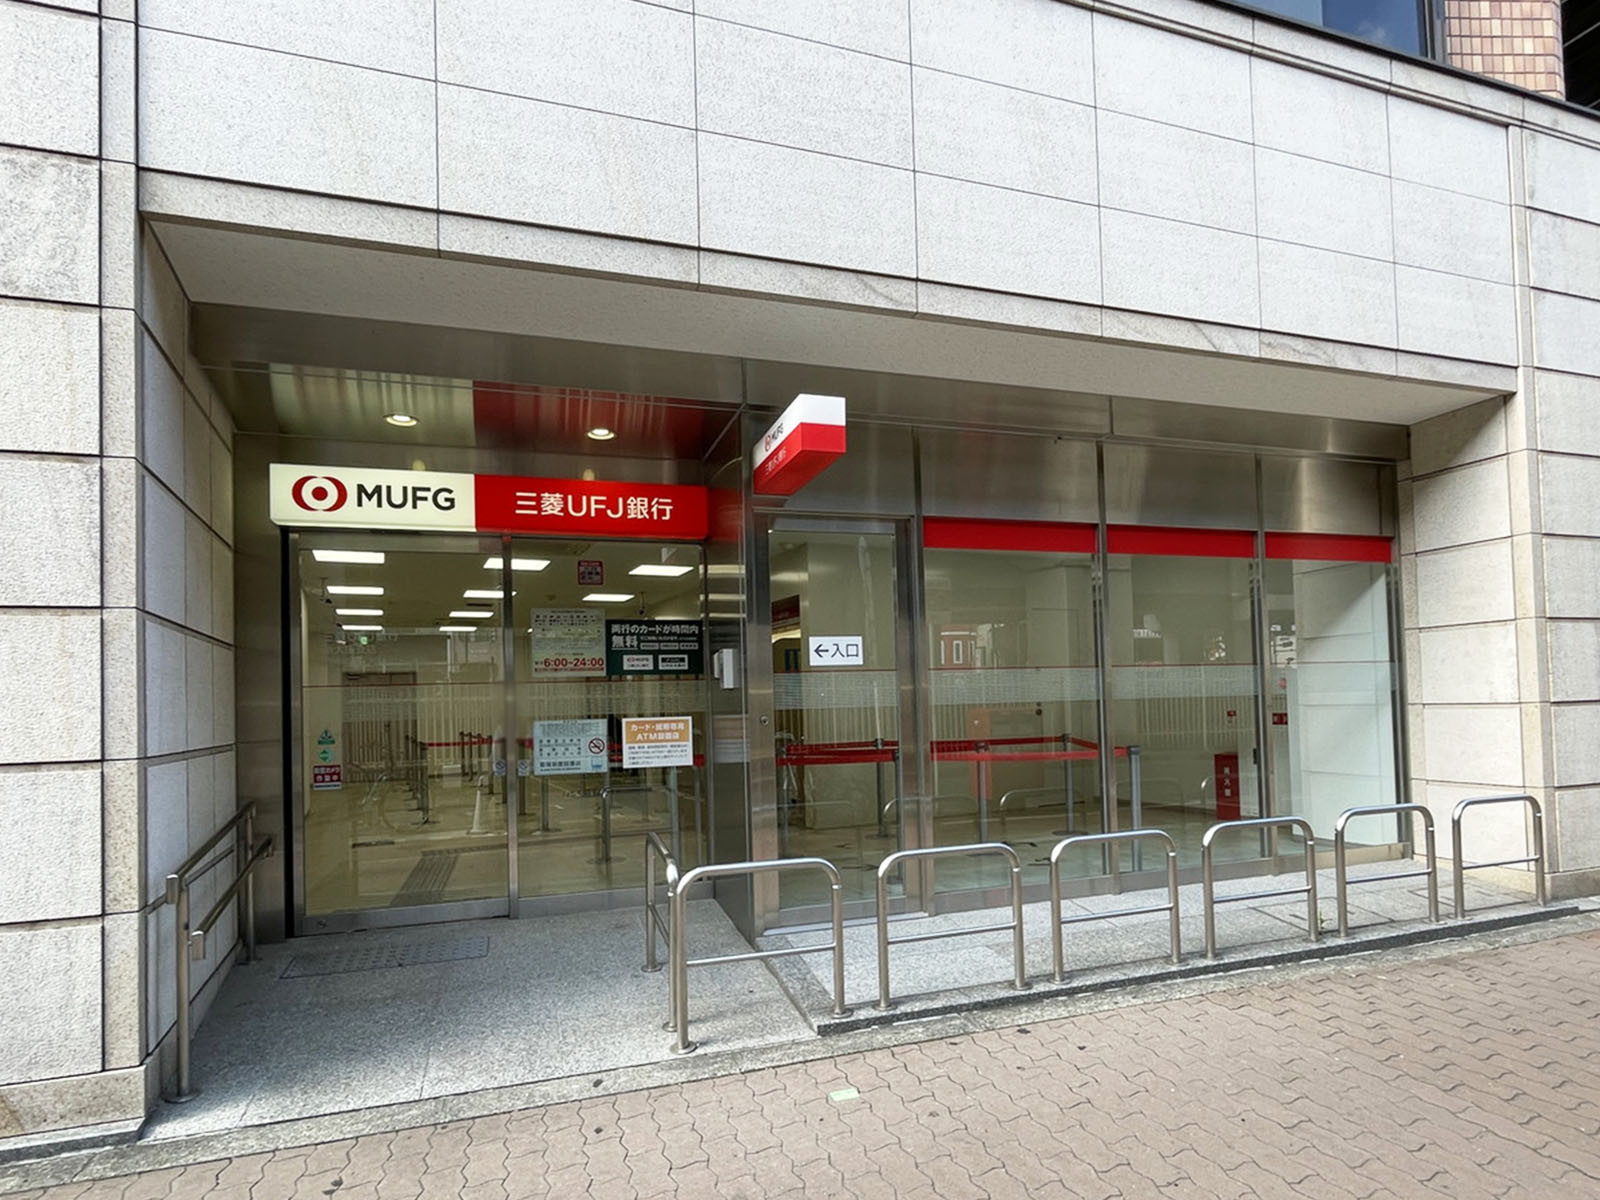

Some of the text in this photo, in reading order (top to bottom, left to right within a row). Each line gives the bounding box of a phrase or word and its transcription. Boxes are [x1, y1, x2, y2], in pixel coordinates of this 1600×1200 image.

[357, 483, 456, 512] MUFG
[514, 492, 674, 521] 三菱UFJ銀行
[611, 635, 638, 648] 無料
[831, 643, 859, 658] 入口
